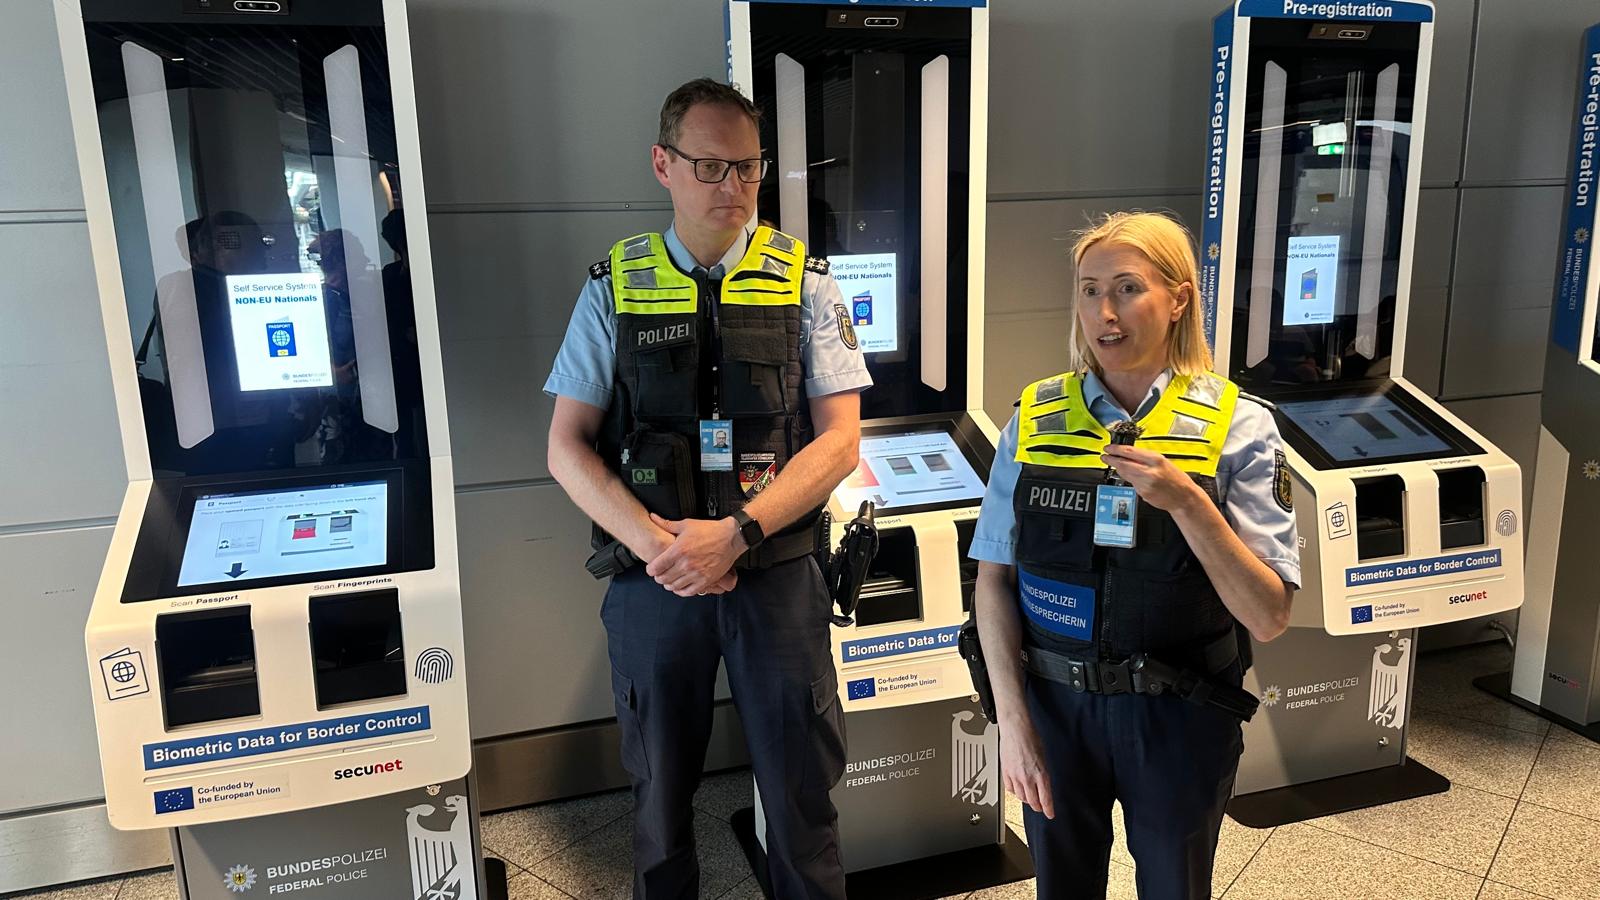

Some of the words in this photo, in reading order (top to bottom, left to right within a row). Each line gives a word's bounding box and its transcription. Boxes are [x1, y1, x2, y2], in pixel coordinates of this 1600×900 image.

[1283, 0, 1393, 18] Pre-registration
[1208, 45, 1229, 219] Pre-registration
[1317, 242, 1336, 250] System
[831, 263, 844, 271] Self
[845, 262, 868, 270] Service
[869, 261, 892, 270] System
[1564, 248, 1573, 274] FEDERAL
[860, 272, 892, 280] Nationals
[1568, 248, 1583, 310] BUNDESPOLIZEI
[233, 284, 250, 293] Self
[252, 284, 283, 292] Service
[285, 282, 317, 292] System
[235, 296, 272, 305] NON-EU
[274, 294, 317, 303] Nationals
[1206, 265, 1216, 335] BUNDESPOLIZEI
[637, 323, 689, 346] POLIZEI
[1029, 486, 1091, 512] POLIZEI
[1350, 568, 1394, 582] Biometric
[1396, 565, 1417, 576] Data
[1419, 562, 1432, 573] for
[1434, 559, 1463, 571] Border
[1465, 555, 1498, 567] Control
[313, 583, 335, 591] Scan
[337, 577, 393, 588] Fingerprints
[170, 600, 194, 608] Scan
[195, 594, 238, 605] Passport
[1374, 603, 1401, 611] Co-funded
[1449, 590, 1487, 605] secunet
[1383, 608, 1406, 617] European
[1406, 607, 1420, 615] Union
[848, 639, 905, 657] Biometric
[907, 634, 934, 648] Data
[937, 631, 954, 643] for
[877, 674, 909, 684] Co-funded
[909, 673, 918, 681] by
[889, 681, 919, 691] European
[919, 678, 936, 686] Union
[1286, 677, 1359, 697] BUNDESPOLIZEI
[1286, 698, 1319, 710] FEDERAL
[1319, 693, 1345, 703] POLICE
[152, 741, 232, 763] Biometric
[237, 733, 275, 750] Data
[279, 728, 302, 744] for
[307, 721, 360, 740] Border
[365, 712, 422, 731] Control
[334, 758, 403, 780] secunet
[845, 748, 936, 774] BUNDESPOLIZEI
[846, 773, 887, 788] FEDERAL
[888, 767, 920, 780] POLICE
[197, 782, 242, 795] Co-funded
[243, 781, 254, 791] by
[198, 795, 212, 804] the
[214, 791, 254, 804] European
[256, 785, 281, 796] Union
[266, 847, 387, 878] BUNDESPOLIZEI
[269, 877, 323, 894] FEDERAL
[326, 869, 368, 884] POLICE
